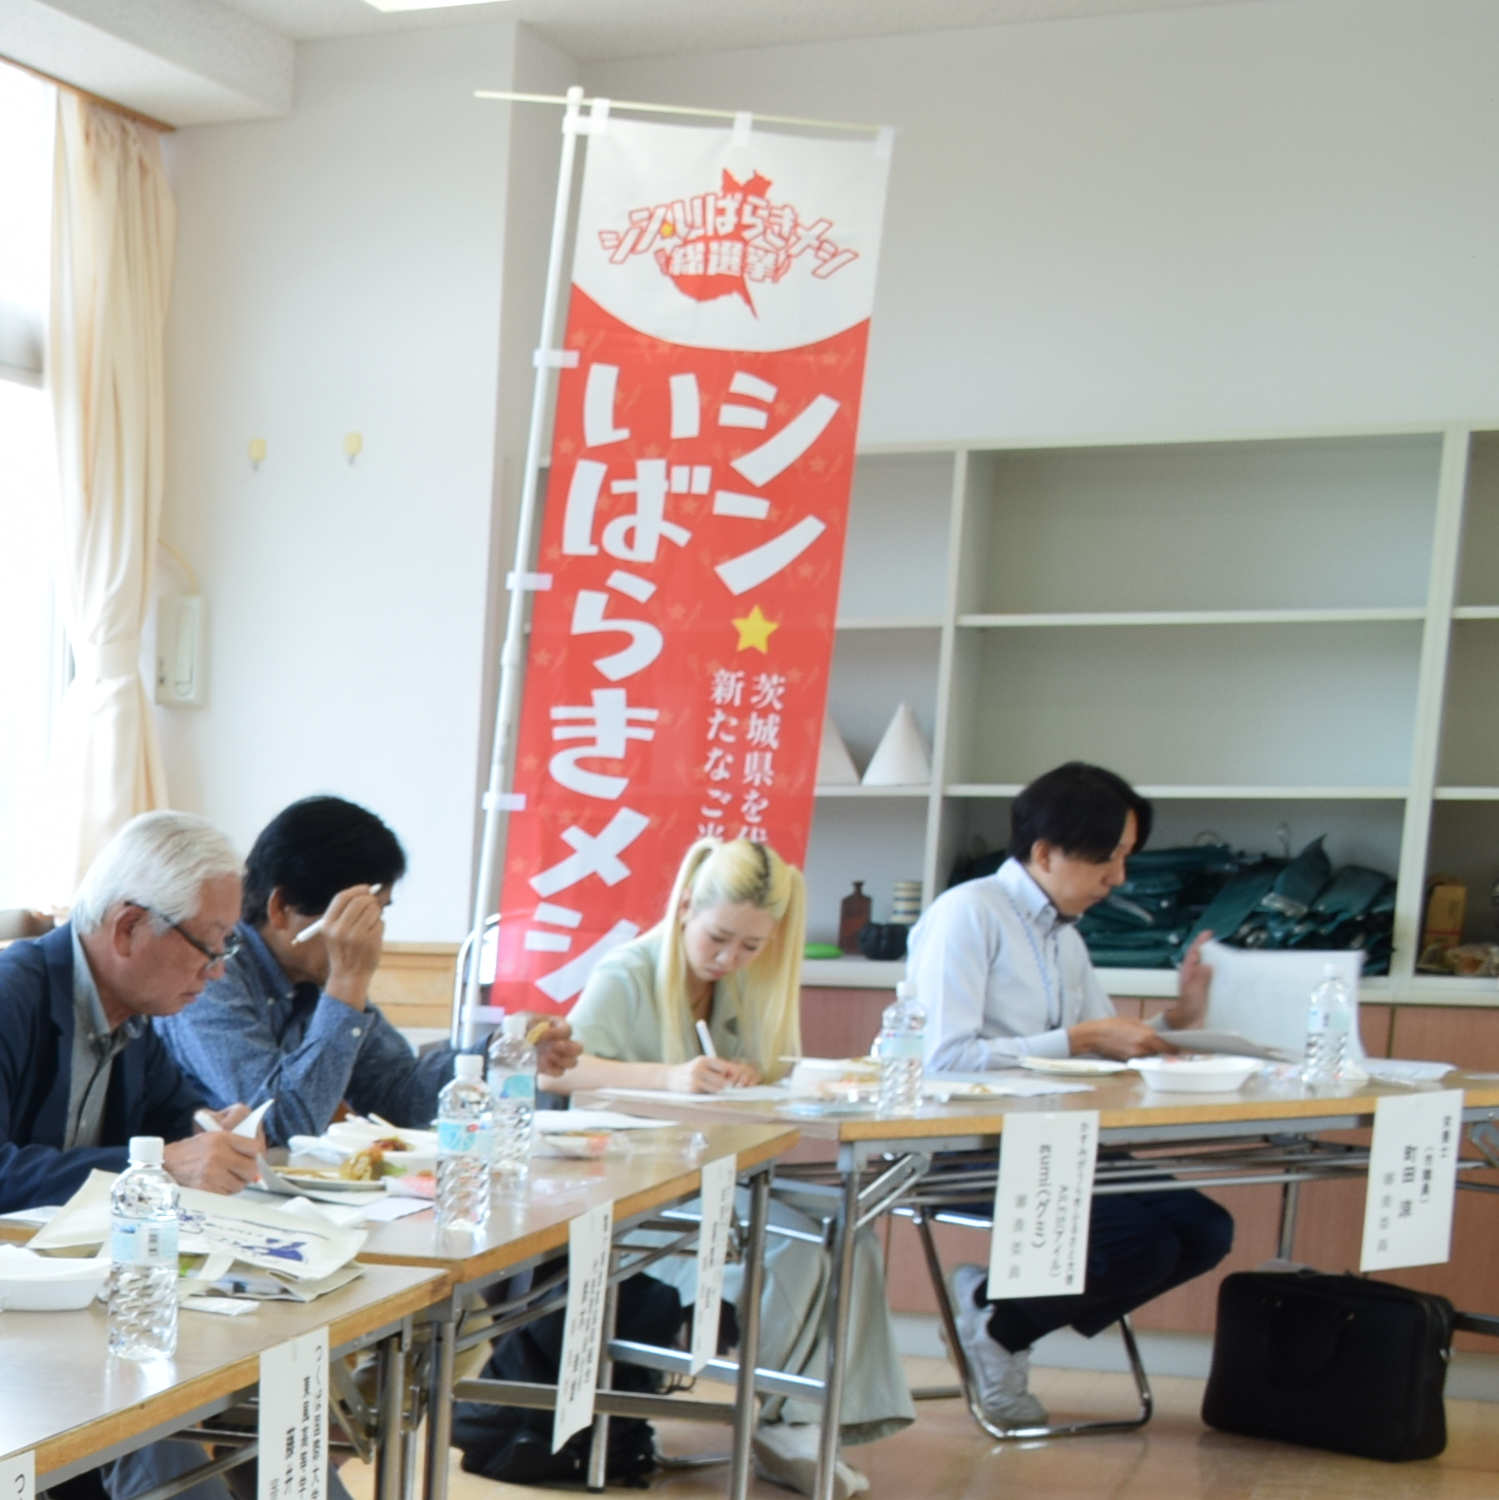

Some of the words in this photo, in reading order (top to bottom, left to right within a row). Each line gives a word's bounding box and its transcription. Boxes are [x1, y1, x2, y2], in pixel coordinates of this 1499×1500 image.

[525, 363, 711, 1005] いばらきメシ
[714, 370, 841, 596] シン
